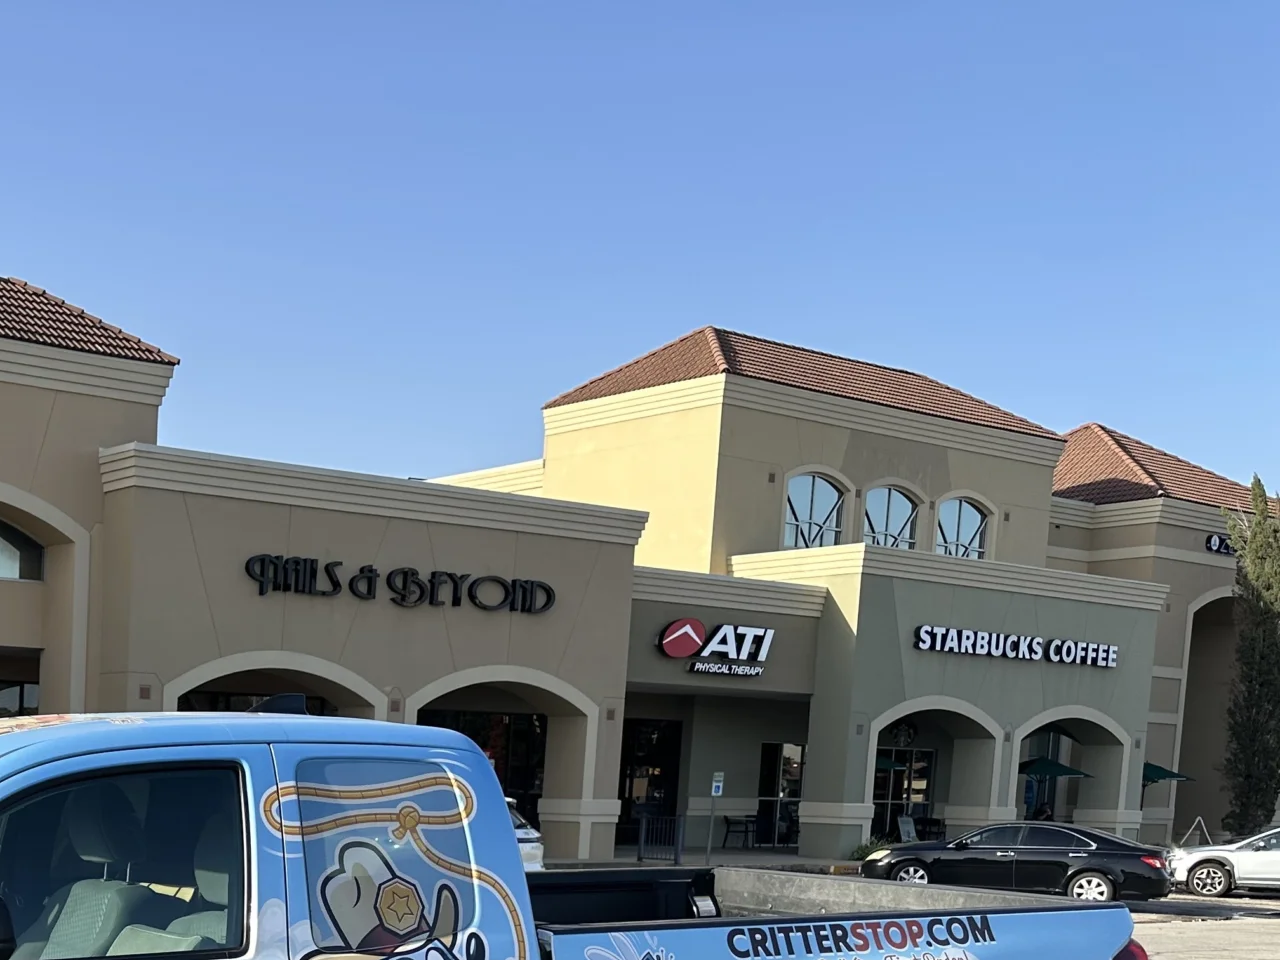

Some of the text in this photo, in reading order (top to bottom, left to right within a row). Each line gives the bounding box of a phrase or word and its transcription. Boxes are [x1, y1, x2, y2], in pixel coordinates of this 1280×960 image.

[245, 554, 556, 615] NAILS & BEYOND
[700, 624, 776, 662] ATI
[918, 624, 1120, 668] STARBUCKS COFFEE
[694, 662, 765, 676] PHYSICAL THERAPY
[726, 916, 997, 960] CRITTERSTOP.COM
